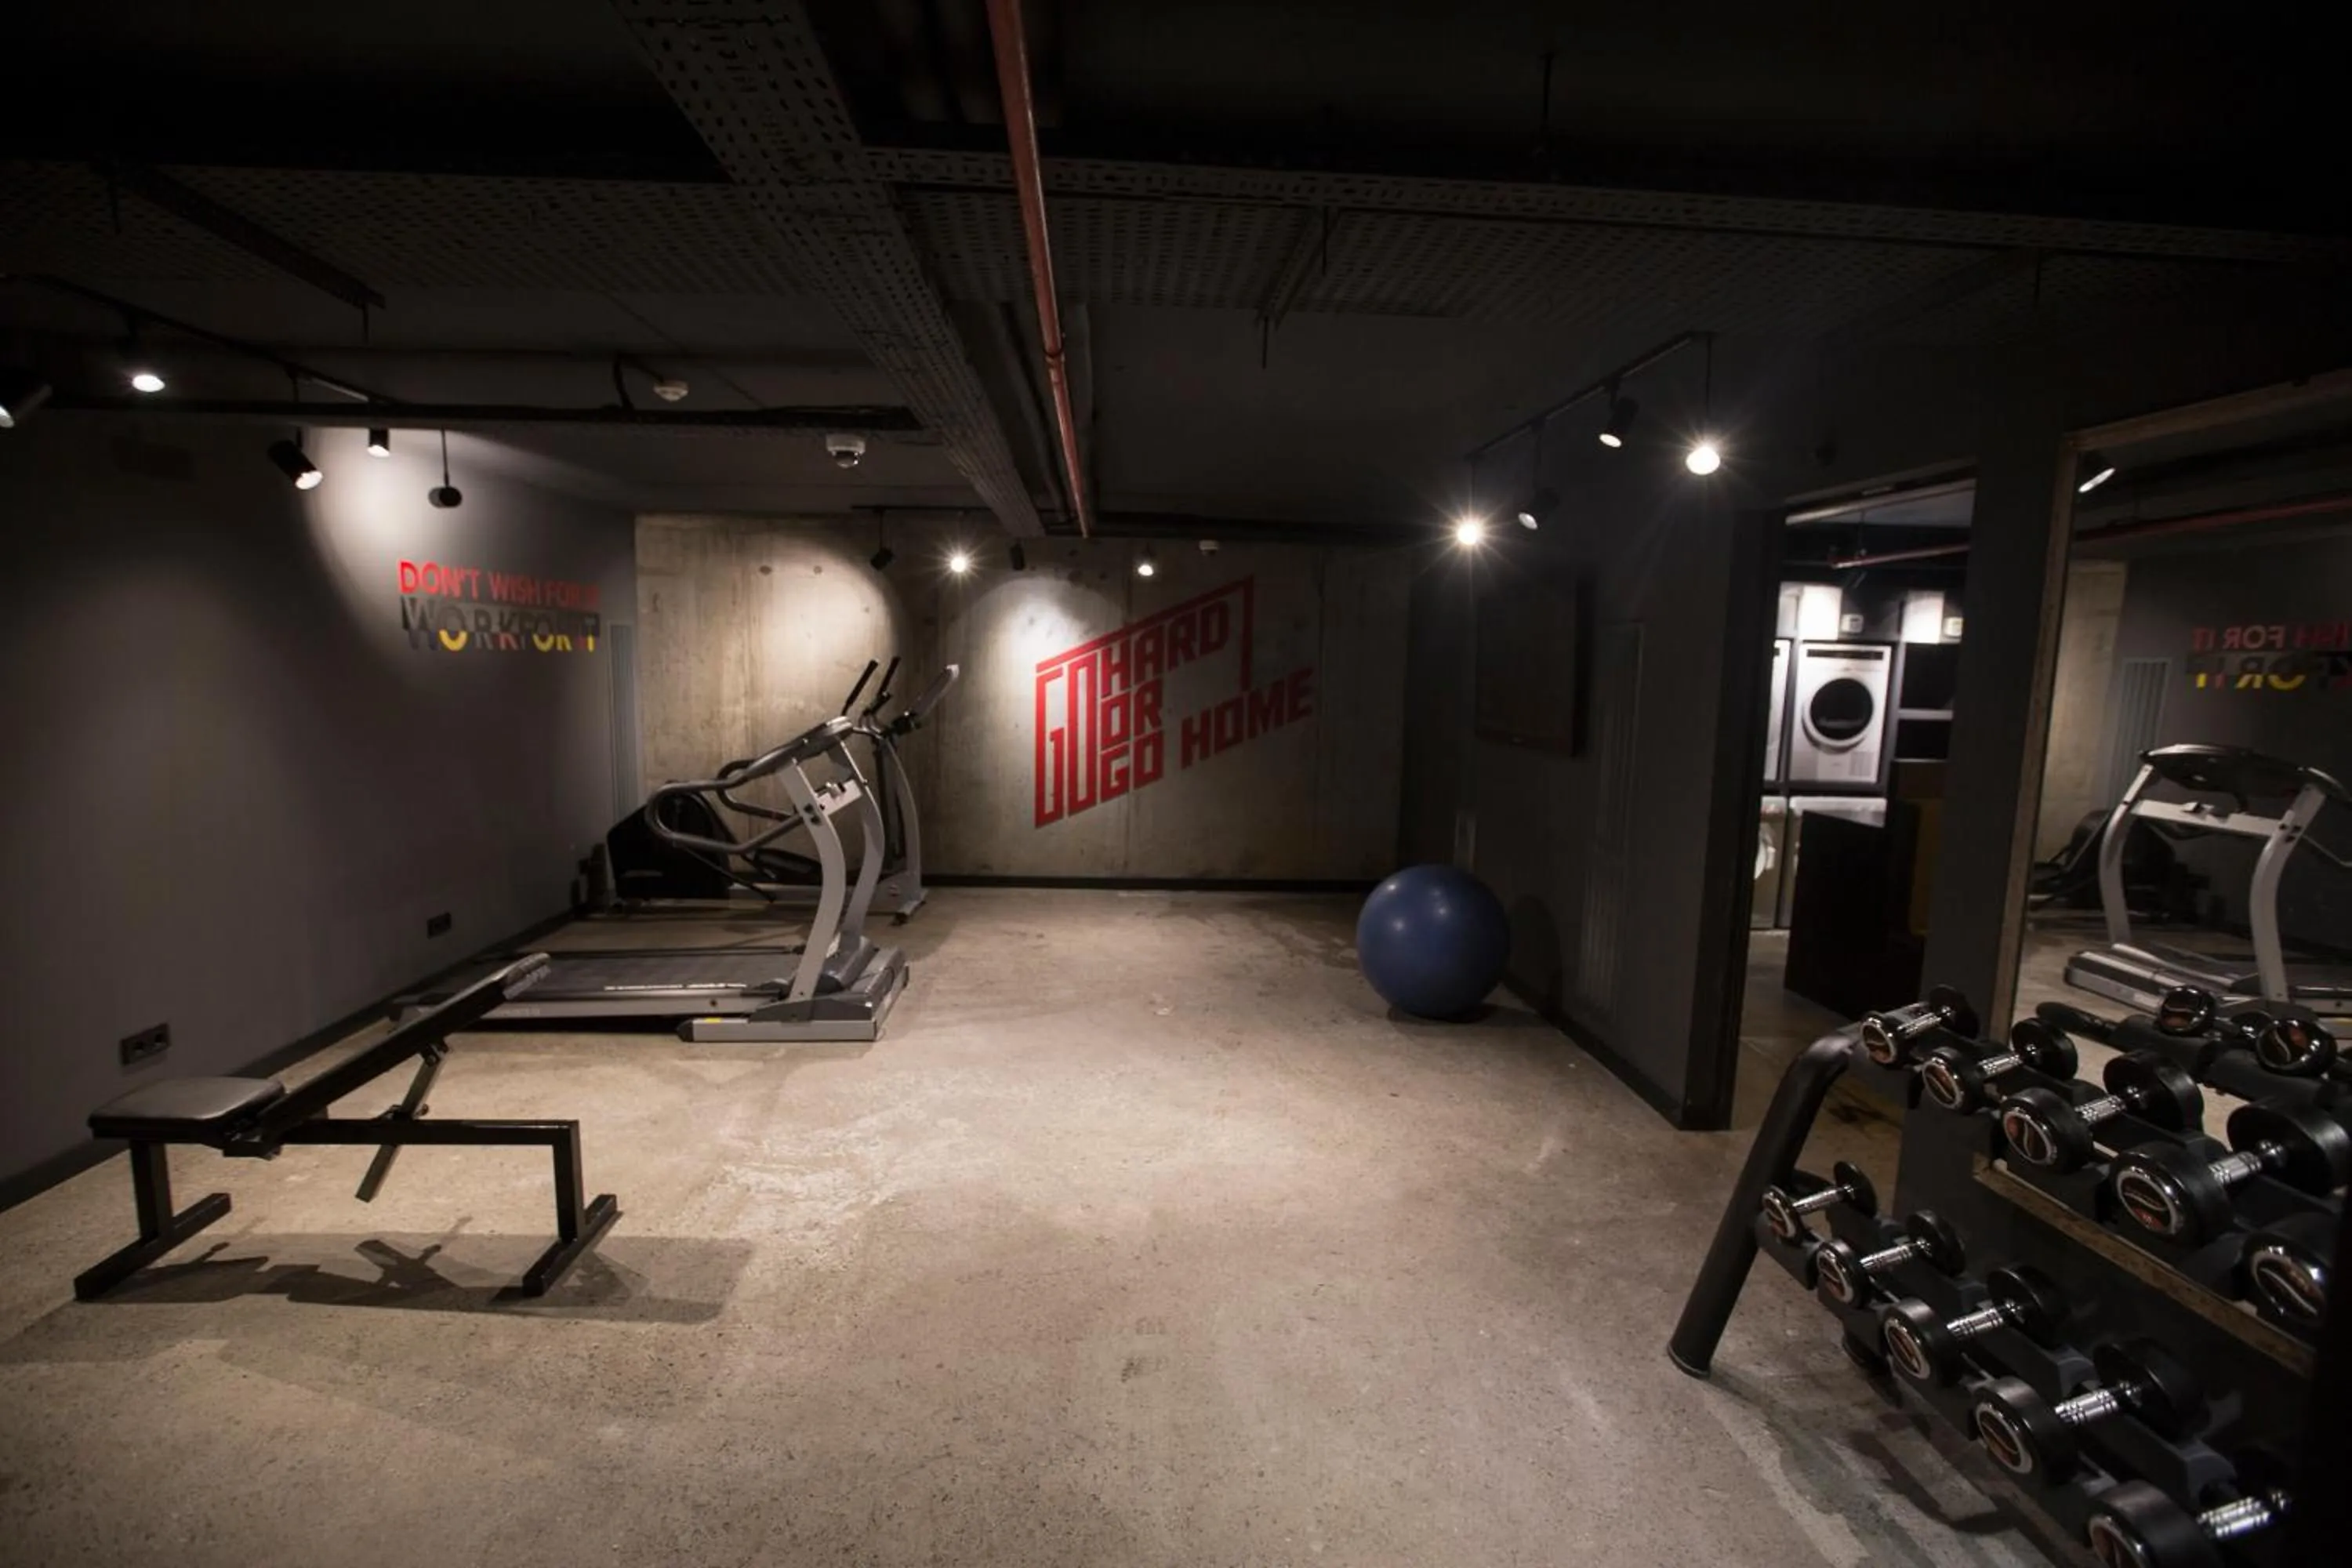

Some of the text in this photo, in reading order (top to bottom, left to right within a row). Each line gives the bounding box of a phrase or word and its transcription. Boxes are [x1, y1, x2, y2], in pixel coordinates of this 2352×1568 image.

[397, 559, 481, 599] DON'T
[488, 570, 542, 607] WISH
[543, 581, 582, 608] FOR
[1101, 600, 1229, 698] HARD
[1101, 677, 1163, 748] OR
[1101, 667, 1313, 803] GO HOME
